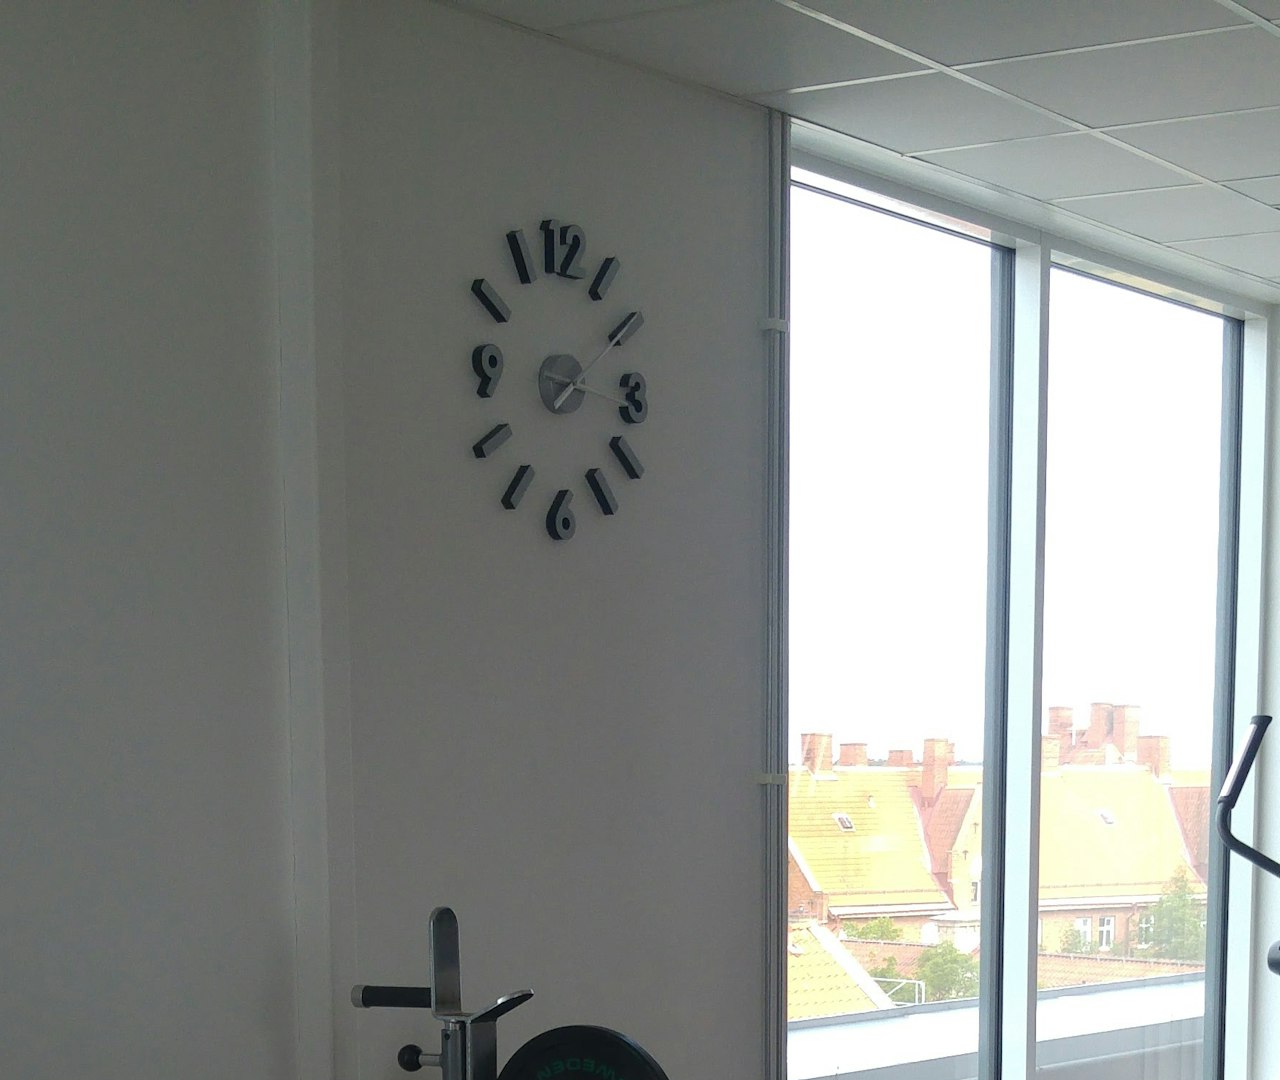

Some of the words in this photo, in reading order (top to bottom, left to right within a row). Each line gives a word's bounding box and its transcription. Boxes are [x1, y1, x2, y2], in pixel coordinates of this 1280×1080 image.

[539, 218, 587, 280] 12
[471, 343, 505, 398] 9
[618, 371, 649, 424] 3
[545, 489, 577, 541] 6
